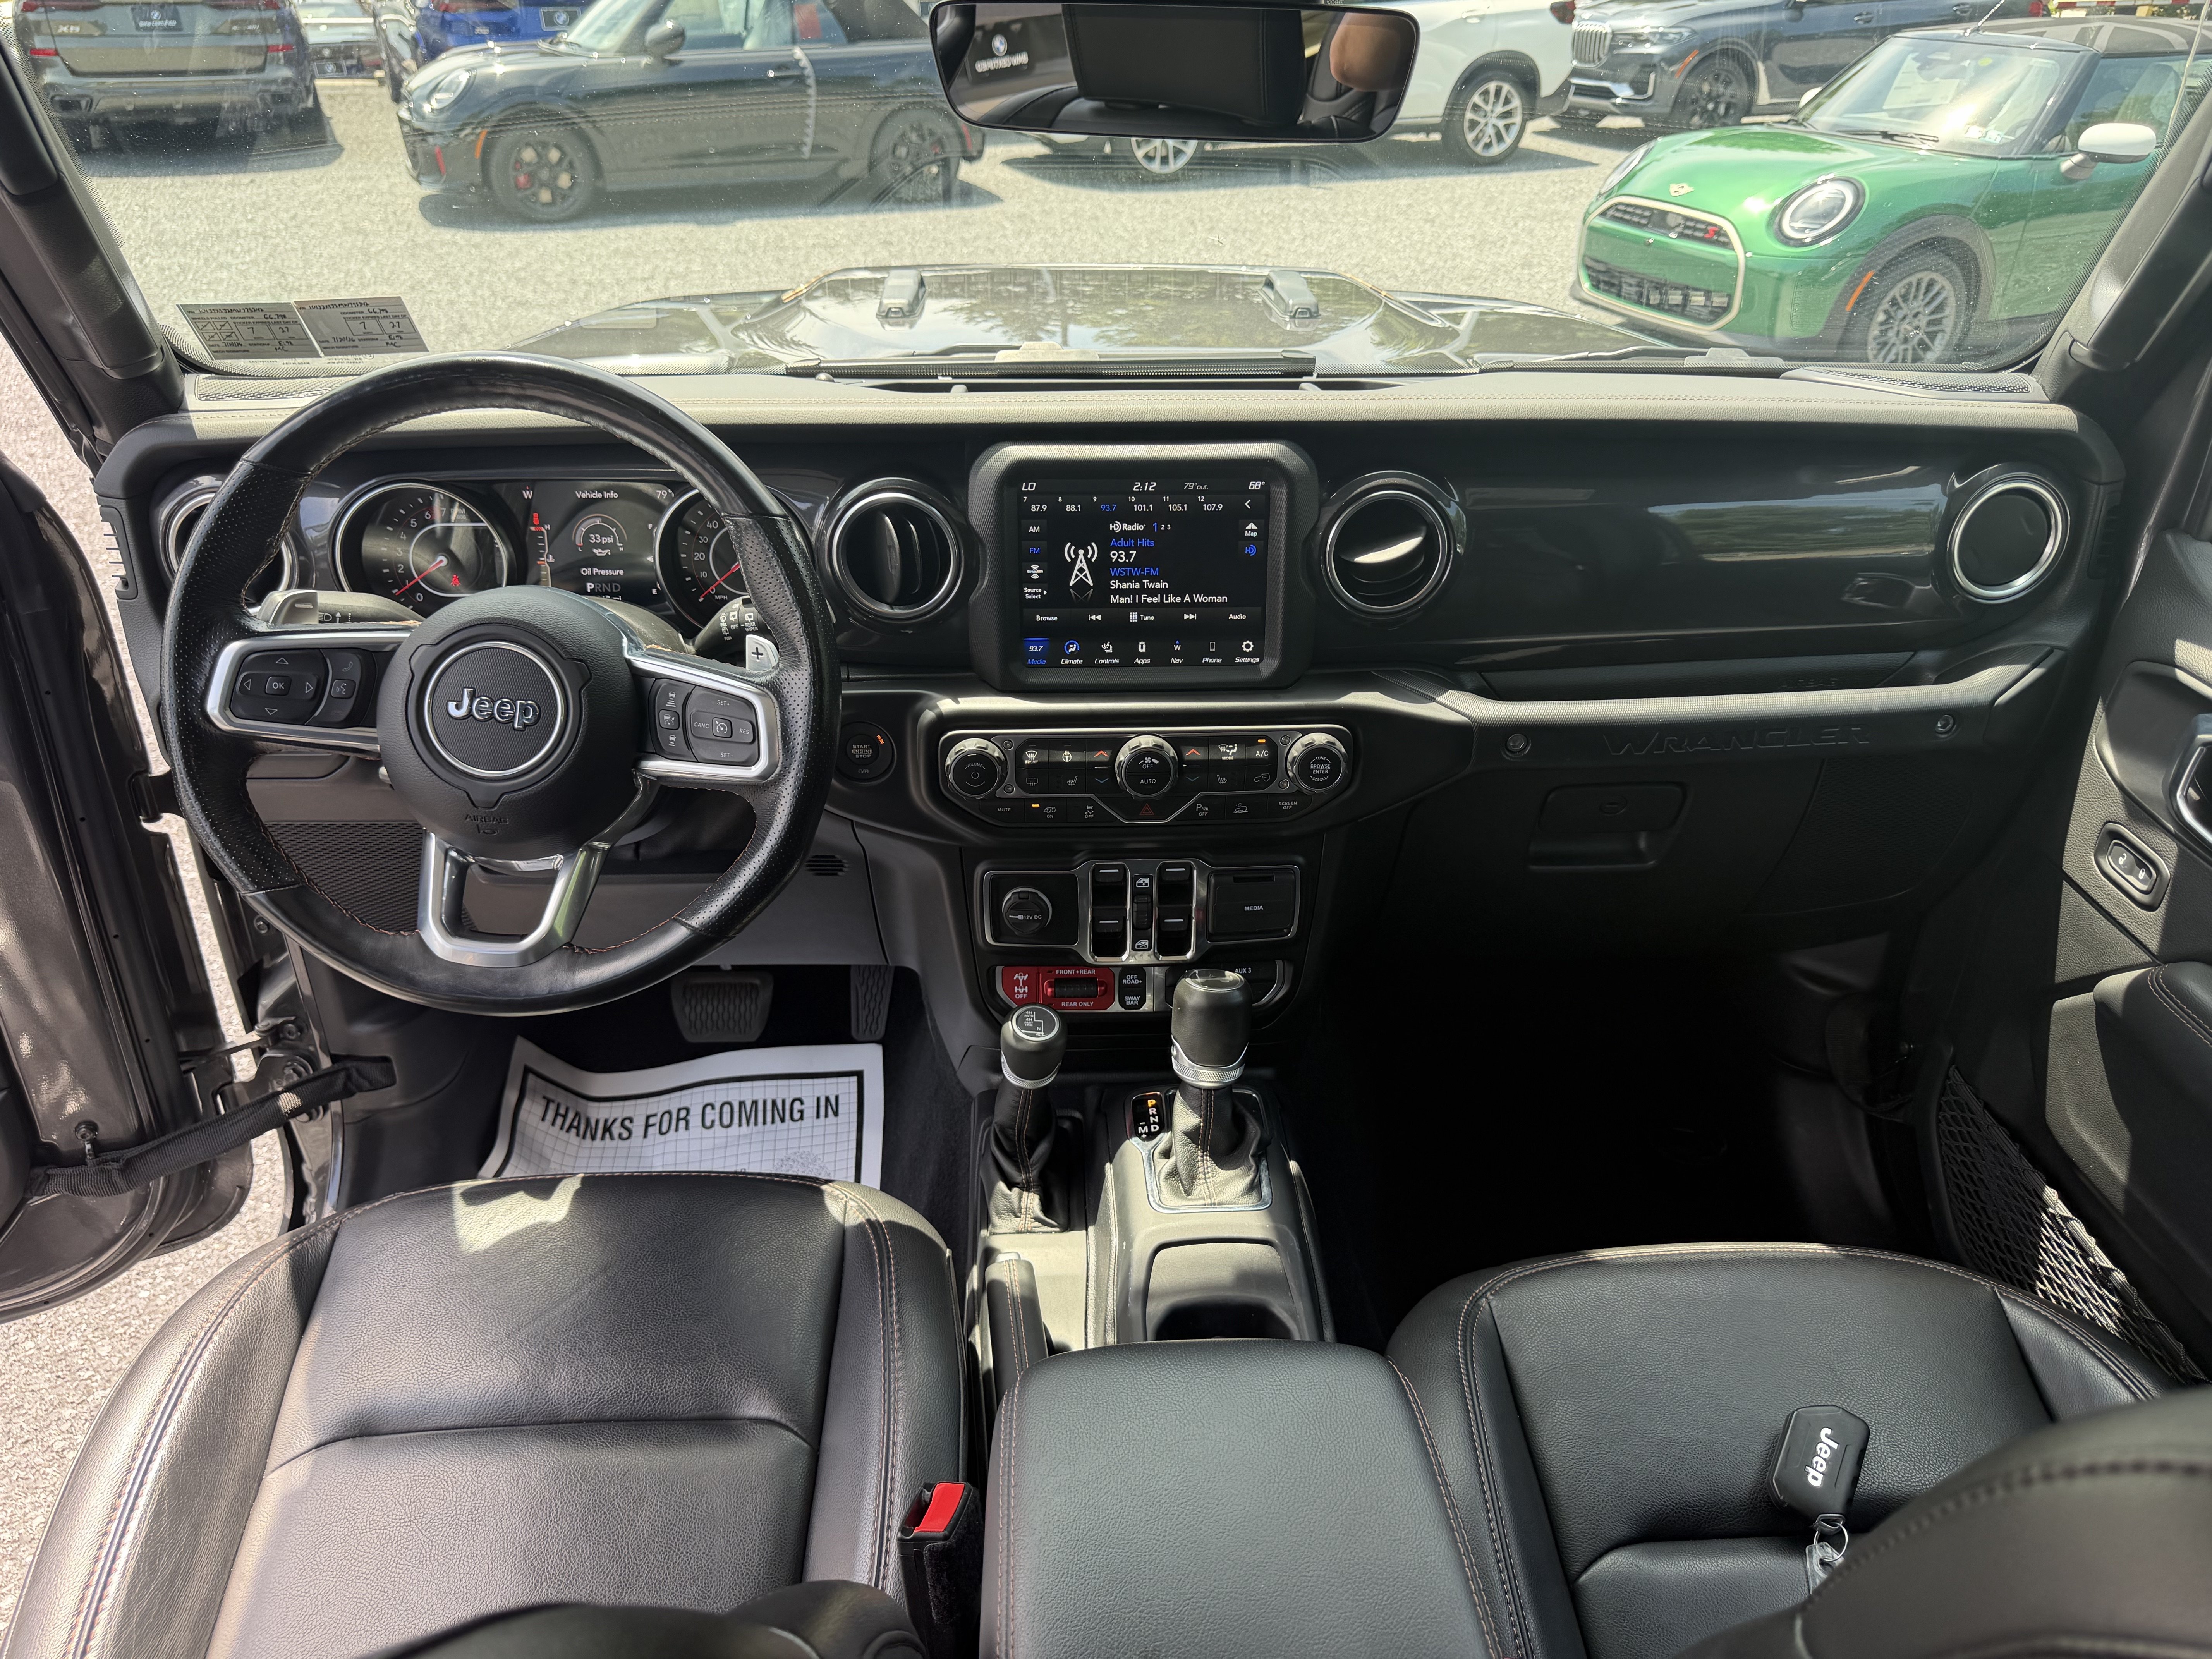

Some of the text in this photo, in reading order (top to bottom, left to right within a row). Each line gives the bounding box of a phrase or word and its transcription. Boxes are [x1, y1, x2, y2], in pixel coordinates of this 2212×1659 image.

[359, 321, 367, 330] 7
[247, 326, 254, 335] 7
[1022, 482, 1036, 491] LO
[1133, 482, 1157, 491] 2:12
[1248, 481, 1265, 490] 68°
[522, 490, 533, 499] W
[575, 491, 603, 499] Vehicle
[425, 510, 431, 520] 6
[410, 518, 417, 528] 5
[707, 520, 719, 529] 40
[1153, 522, 1158, 532] 1
[400, 532, 407, 541] 4
[589, 534, 613, 544] 33 psi
[1110, 538, 1155, 547] Adult Hits
[397, 547, 403, 556] 3
[1110, 550, 1137, 562] 93.7
[694, 552, 706, 561] 20
[398, 564, 404, 573] 2
[581, 567, 624, 576] Oil Pressure
[1110, 567, 1159, 576] WSTW-FM
[1110, 580, 1168, 589] Shania Twain
[416, 592, 424, 602] 0
[1110, 594, 1228, 604] Man! I Feel Like A Woman
[447, 687, 540, 730] Jeep
[876, 735, 884, 744] RUN
[1602, 724, 1870, 756] WRANGLER
[465, 814, 509, 824] AIRBAG
[1147, 1099, 1156, 1108] P
[541, 1094, 840, 1142] THANKS FOR COMING IN
[1138, 1125, 1149, 1133] M
[1804, 1426, 1839, 1487] Jeep
